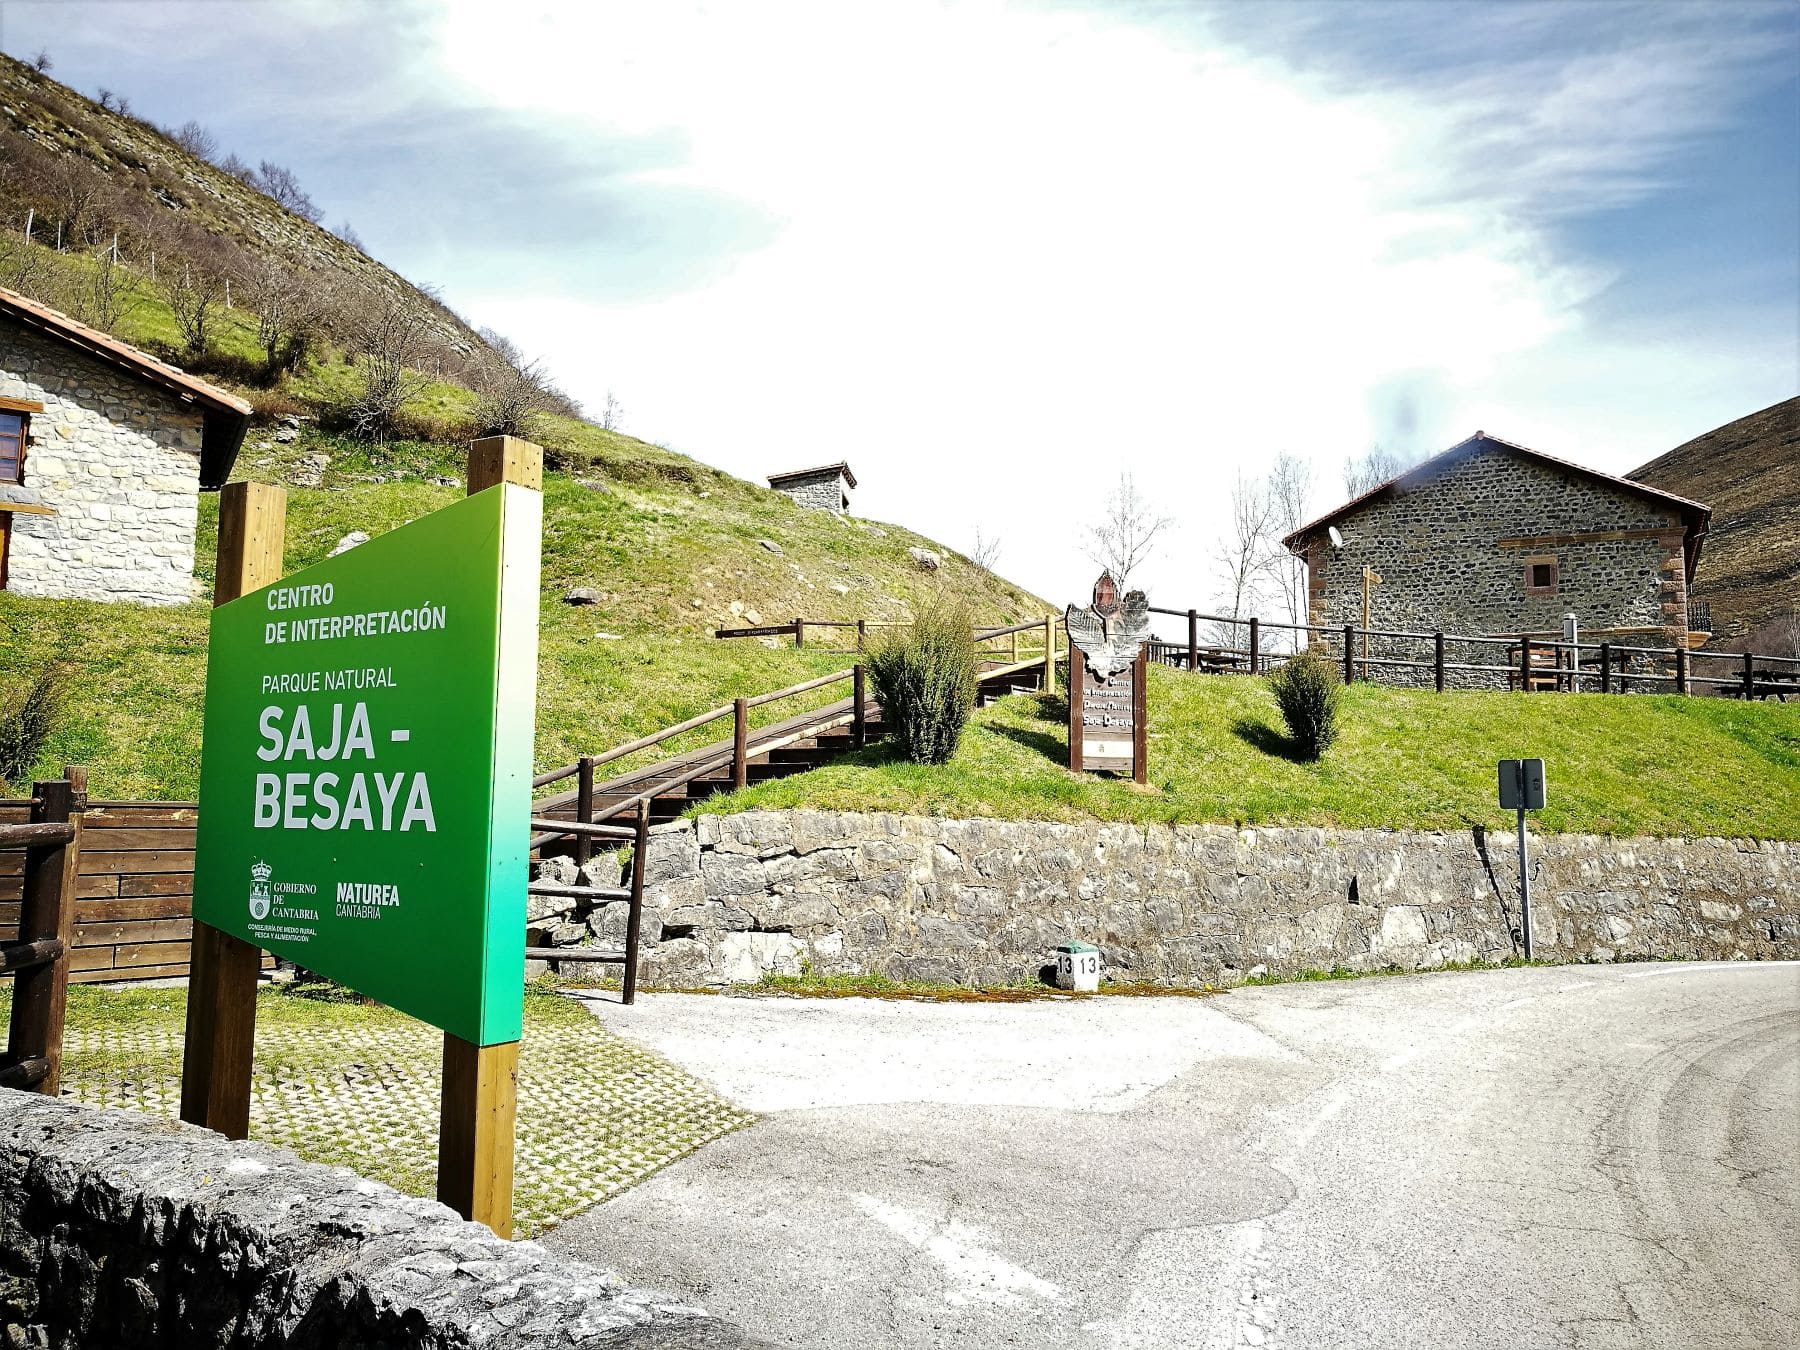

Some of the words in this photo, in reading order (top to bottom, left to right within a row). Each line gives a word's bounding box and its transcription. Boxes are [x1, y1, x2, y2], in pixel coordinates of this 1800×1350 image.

[267, 582, 334, 610] CENTRO
[265, 621, 287, 644] DE
[291, 601, 446, 642] INTERPRETACIÓN
[262, 671, 320, 694] PARQUE
[324, 667, 397, 691] NATURAL
[256, 702, 375, 762] SAJA
[254, 772, 436, 832] BESAYA
[273, 882, 317, 895] GOBIERNO
[336, 882, 400, 907] NATUREA
[273, 895, 285, 905] DE
[272, 907, 319, 920] CANTABRIA
[335, 904, 381, 919] CANTABRIA
[1058, 956, 1072, 974] 13
[1080, 957, 1096, 974] 13
